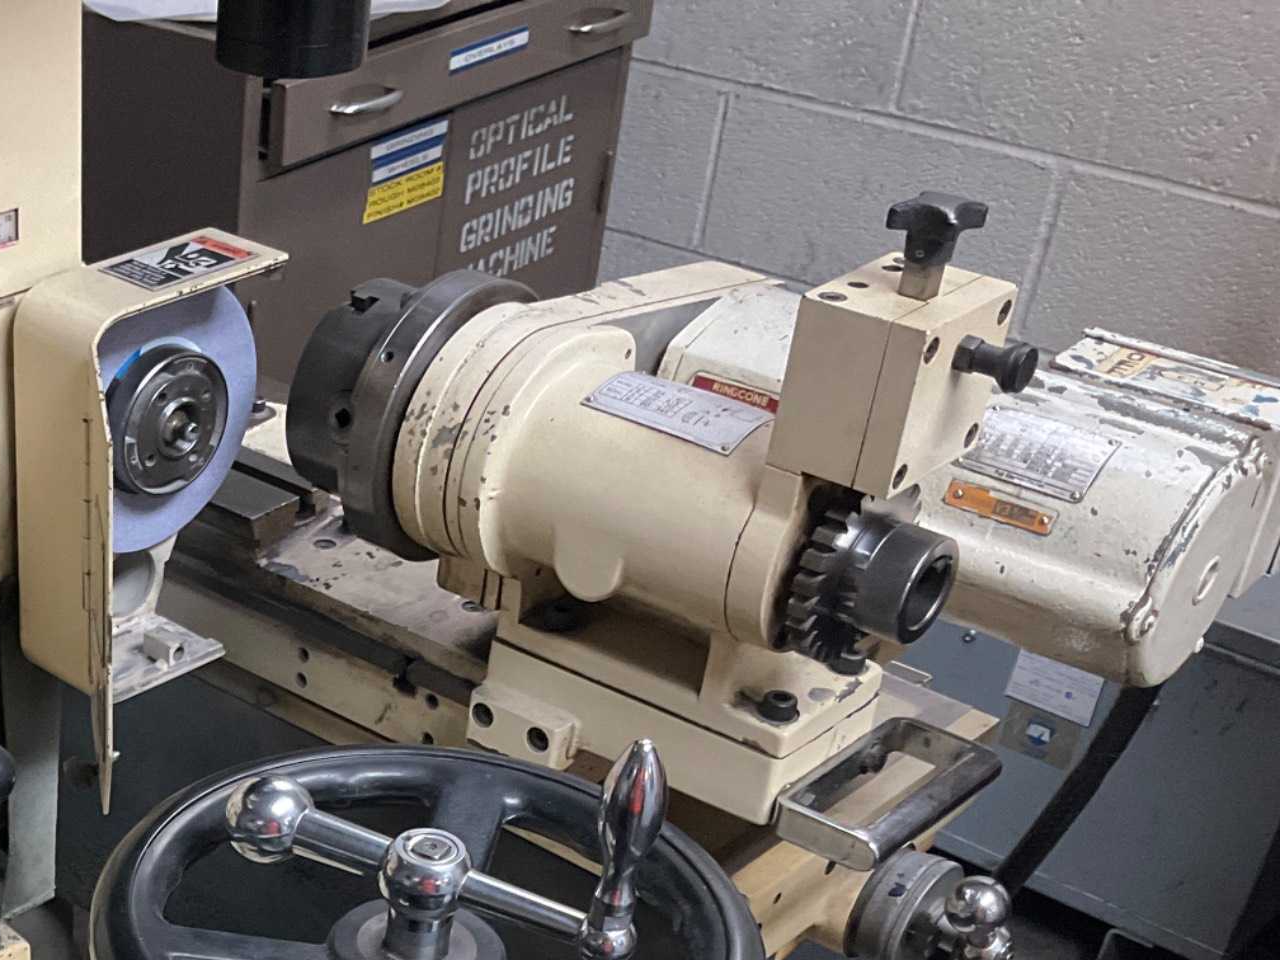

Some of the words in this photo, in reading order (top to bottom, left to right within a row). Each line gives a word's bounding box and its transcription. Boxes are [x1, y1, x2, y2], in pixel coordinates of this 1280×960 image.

[469, 94, 574, 160] OPTICAL
[464, 134, 575, 206] PROFILE
[459, 177, 575, 253] GRINDING
[467, 225, 557, 278] ACHINE
